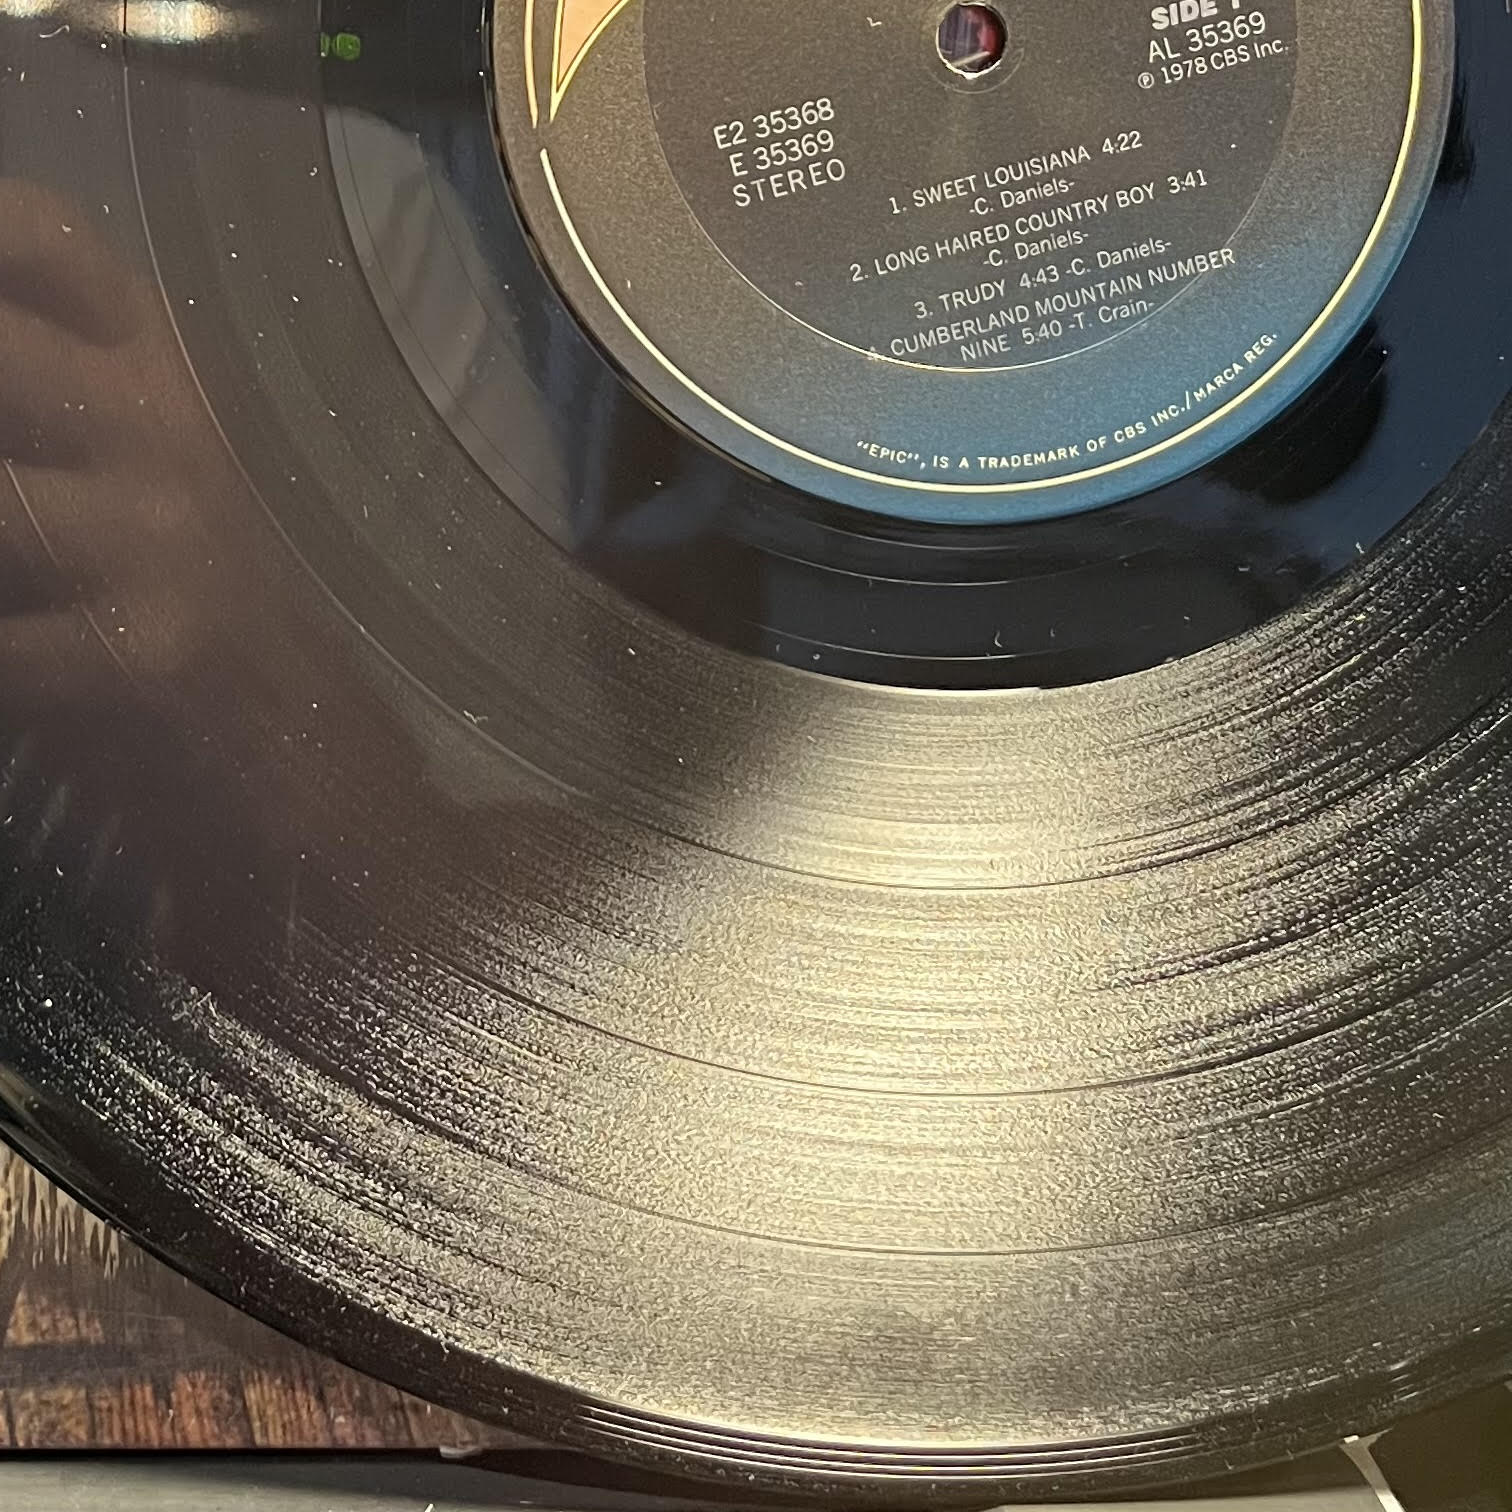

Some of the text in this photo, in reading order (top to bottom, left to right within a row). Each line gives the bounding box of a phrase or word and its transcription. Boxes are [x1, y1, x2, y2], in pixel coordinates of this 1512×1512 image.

[1149, 11, 1266, 63] AL 35369
[1161, 56, 1209, 84] 1978
[1210, 44, 1251, 71] CBS
[1253, 39, 1289, 59] Inc.
[713, 97, 835, 150] E2 35368
[729, 129, 834, 177] E 35369
[888, 130, 1143, 214] 1. SWEET LOUISIANA 4:22
[732, 158, 846, 207] STEREO
[849, 169, 1208, 282] 2. LONG HAIRED COUNTRY BOY 3:41
[890, 305, 1030, 356] CUMBERLAND
[1034, 273, 1143, 317] MOUNTAIN
[1147, 248, 1236, 286] NUMBER
[914, 301, 934, 319] 3.
[938, 279, 1006, 312] TRUDY
[1019, 264, 1059, 289] 4:43
[960, 334, 1011, 361] NINE
[1021, 319, 1063, 345] 5:40
[932, 455, 949, 469] IS
[958, 456, 969, 468] A
[977, 445, 1080, 469] TRADEMARK
[1086, 435, 1108, 453] OF
[1113, 421, 1148, 443] CBS
[1244, 333, 1278, 364] REG.
